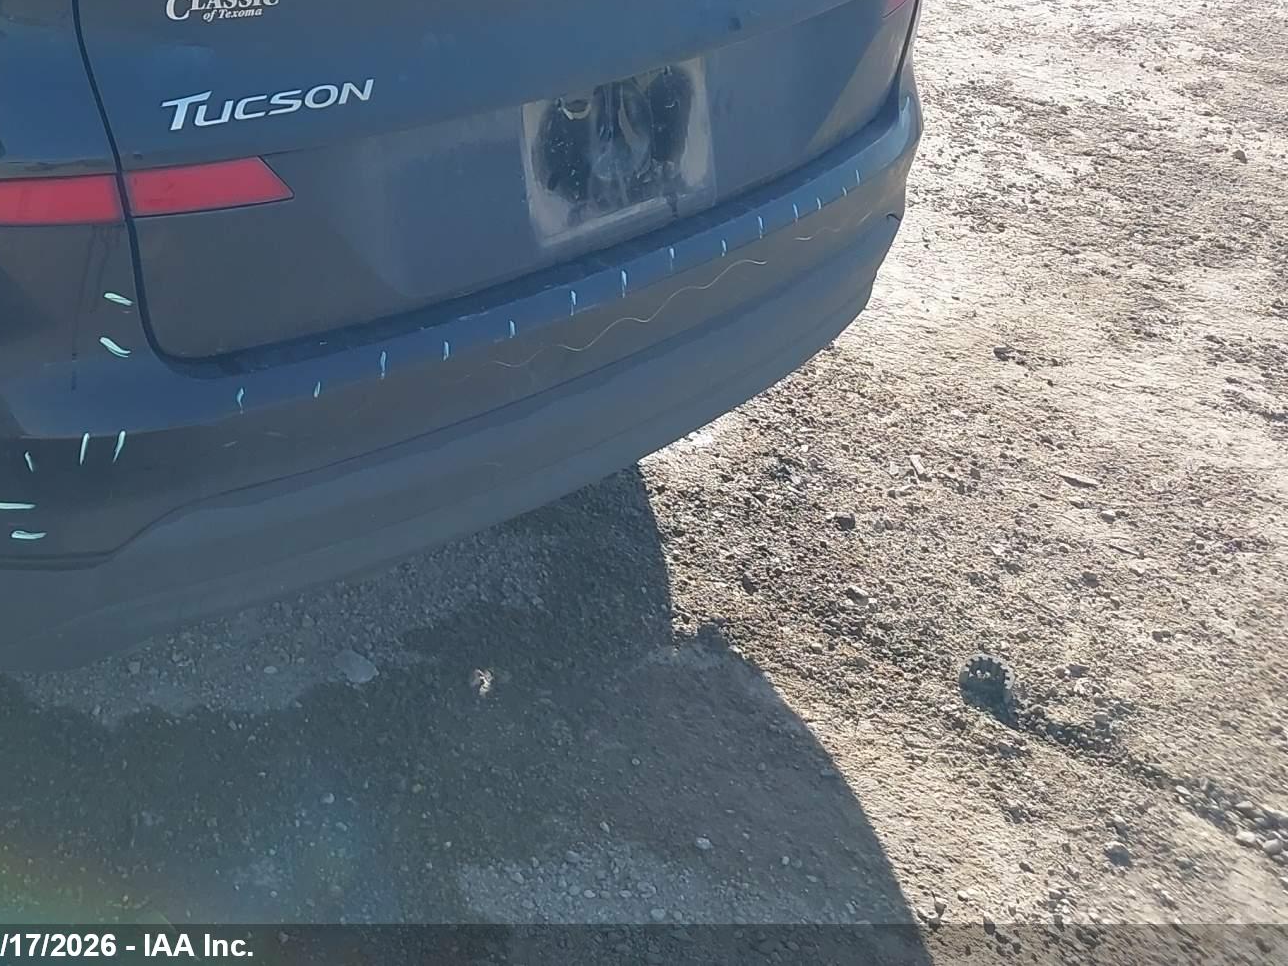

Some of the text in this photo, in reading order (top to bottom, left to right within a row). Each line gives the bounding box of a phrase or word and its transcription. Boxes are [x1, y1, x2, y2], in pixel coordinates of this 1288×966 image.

[202, 6, 263, 22] of Texoma
[161, 78, 375, 131] TUCSON
